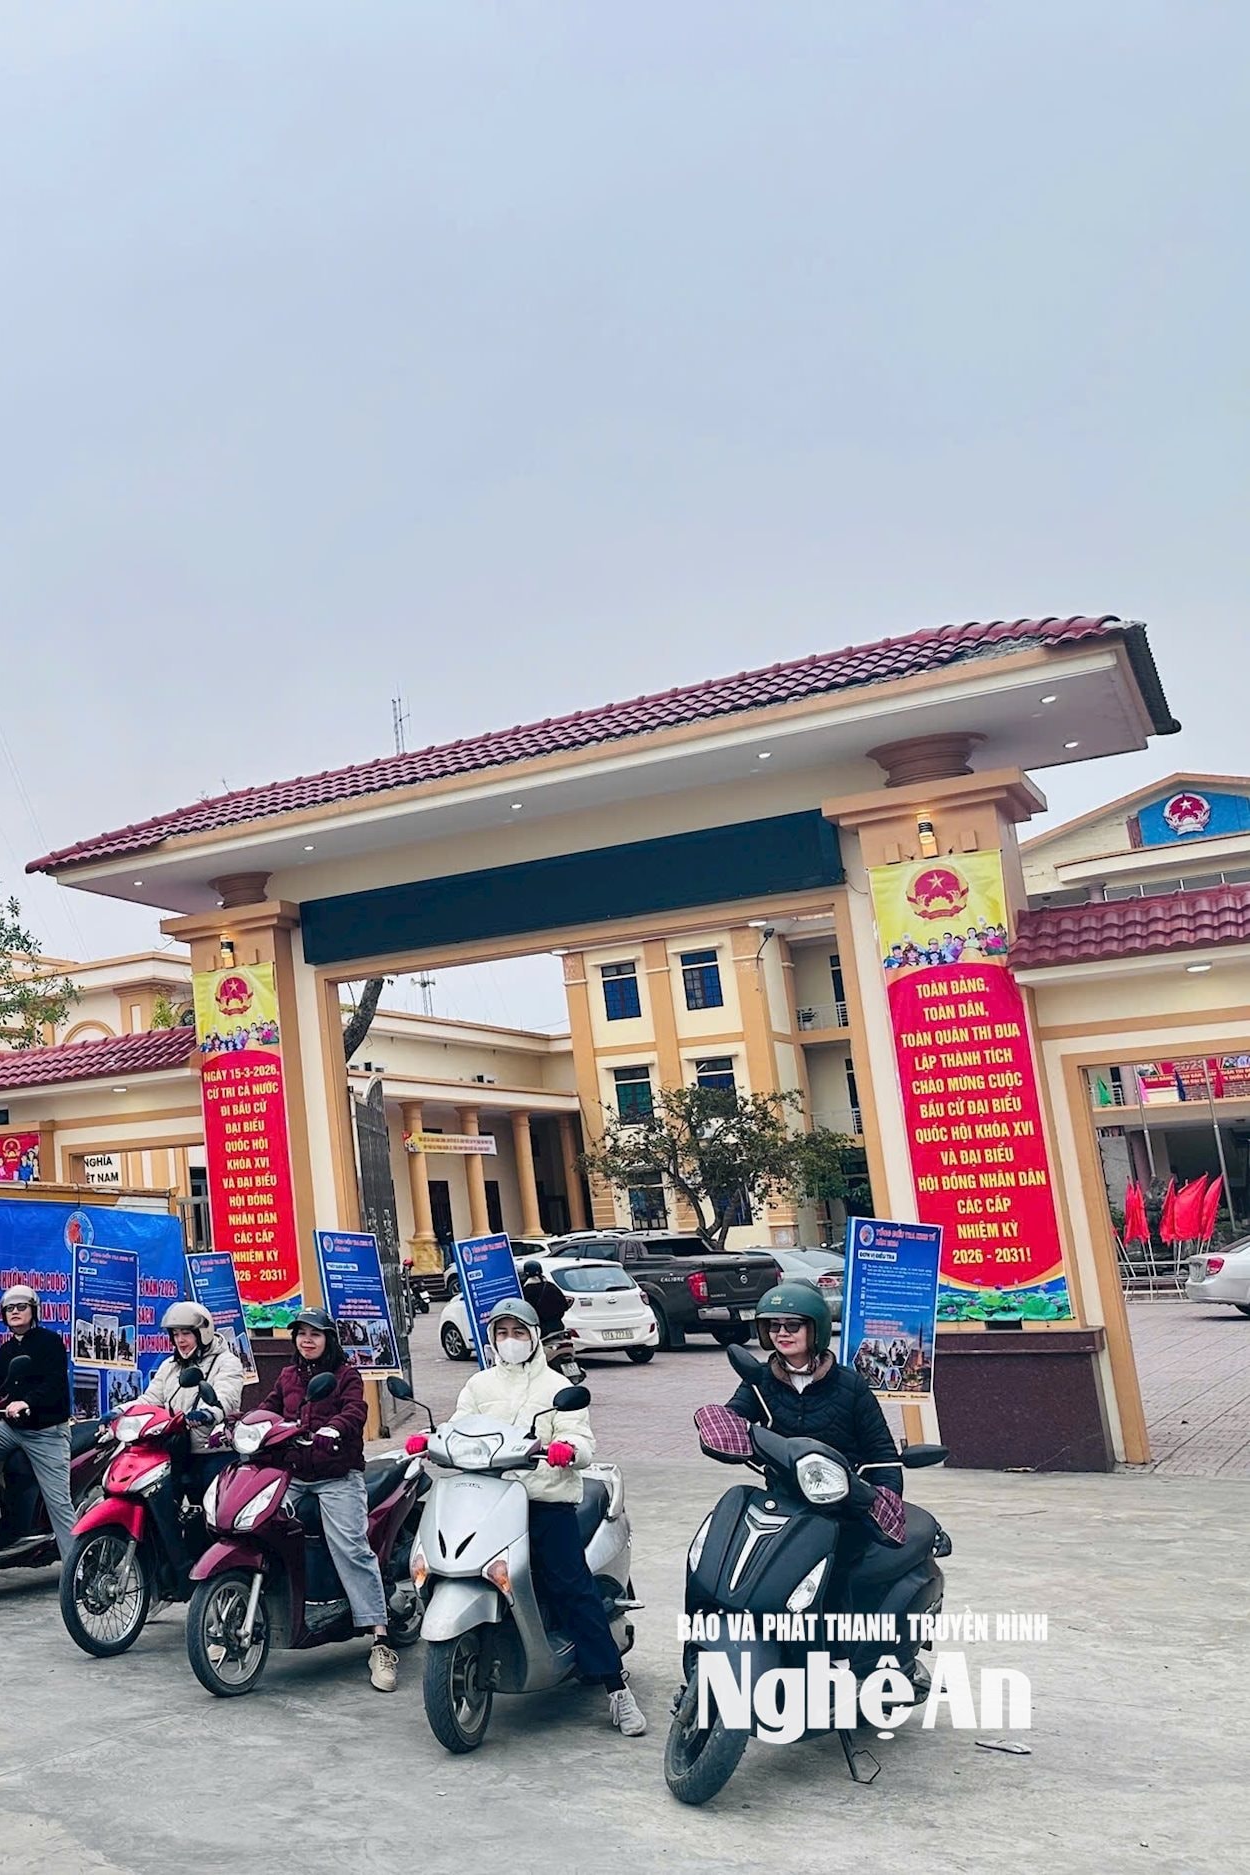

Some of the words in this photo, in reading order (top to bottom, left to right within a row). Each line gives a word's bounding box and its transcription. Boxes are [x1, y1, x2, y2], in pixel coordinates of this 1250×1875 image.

[916, 980, 948, 999] TOÀN
[950, 975, 990, 995] ĐẢNG,
[923, 1003, 956, 1022] TOÀN
[958, 1000, 989, 1018] DÂN,
[901, 1029, 932, 1048] TOÀN
[935, 1026, 970, 1046] QUÂN
[971, 1025, 992, 1041] THI
[994, 1022, 1021, 1039] ĐUA
[914, 1053, 937, 1073] LẬP
[939, 1050, 982, 1069] THÀNH
[983, 1046, 1013, 1065] TÍCH
[203, 1068, 227, 1082] NGÀY
[912, 1076, 945, 1095] CHÀO
[947, 1073, 985, 1092] MỪNG
[988, 1070, 1023, 1090] CUỘC
[207, 1085, 219, 1100] CỬ
[221, 1087, 235, 1098] TRI
[238, 1082, 250, 1097] CẢ
[252, 1081, 279, 1095] NƯỚC
[220, 1105, 230, 1116] ĐI
[253, 1098, 267, 1113] CỬ
[919, 1098, 945, 1119] BẦU
[947, 1096, 965, 1117] CỬ
[967, 1099, 989, 1118] ĐẠI
[992, 1091, 1022, 1113] BIỂU
[225, 1122, 241, 1136] ĐẠI
[243, 1116, 265, 1132] BIỂU
[915, 1122, 948, 1144] QUỐC
[950, 1122, 972, 1143] HỘI
[975, 1120, 1010, 1139] KHÓA
[1012, 1120, 1035, 1137] XVI
[225, 1136, 250, 1153] QUỐC
[252, 1137, 268, 1152] HỘI
[227, 1156, 252, 1170] KHÓA
[254, 1157, 270, 1168] XVI
[940, 1148, 958, 1166] VÀ
[959, 1149, 982, 1168] ĐẠI
[984, 1142, 1014, 1163] BIỂU
[97, 1172, 119, 1183] NAM
[222, 1176, 235, 1189] VÀ
[236, 1176, 253, 1190] ĐẠI
[255, 1171, 277, 1187] BIỂU
[917, 1173, 939, 1194] HỘI
[941, 1170, 977, 1190] ĐỒNG
[979, 1169, 1015, 1188] NHÂN
[1018, 1168, 1047, 1186] DÂN
[229, 1193, 245, 1209] HỘI
[247, 1191, 274, 1206] ĐỒNG
[957, 1196, 983, 1214] CÁC
[986, 1192, 1011, 1213] CẤP
[228, 1212, 255, 1226] NHÂN
[257, 1211, 278, 1224] DÂN
[234, 1229, 253, 1244] CÁC
[255, 1227, 275, 1243] CẤP
[957, 1220, 999, 1242] NHIỆM
[1002, 1219, 1019, 1237] KỲ
[233, 1249, 264, 1264] NHIỆM
[266, 1248, 279, 1262] KỲ
[952, 1248, 984, 1264] 2026
[994, 1247, 1032, 1263] 2031!
[235, 1270, 251, 1281] 026
[259, 1268, 287, 1282] 2031!
[159, 1278, 179, 1298] 2026
